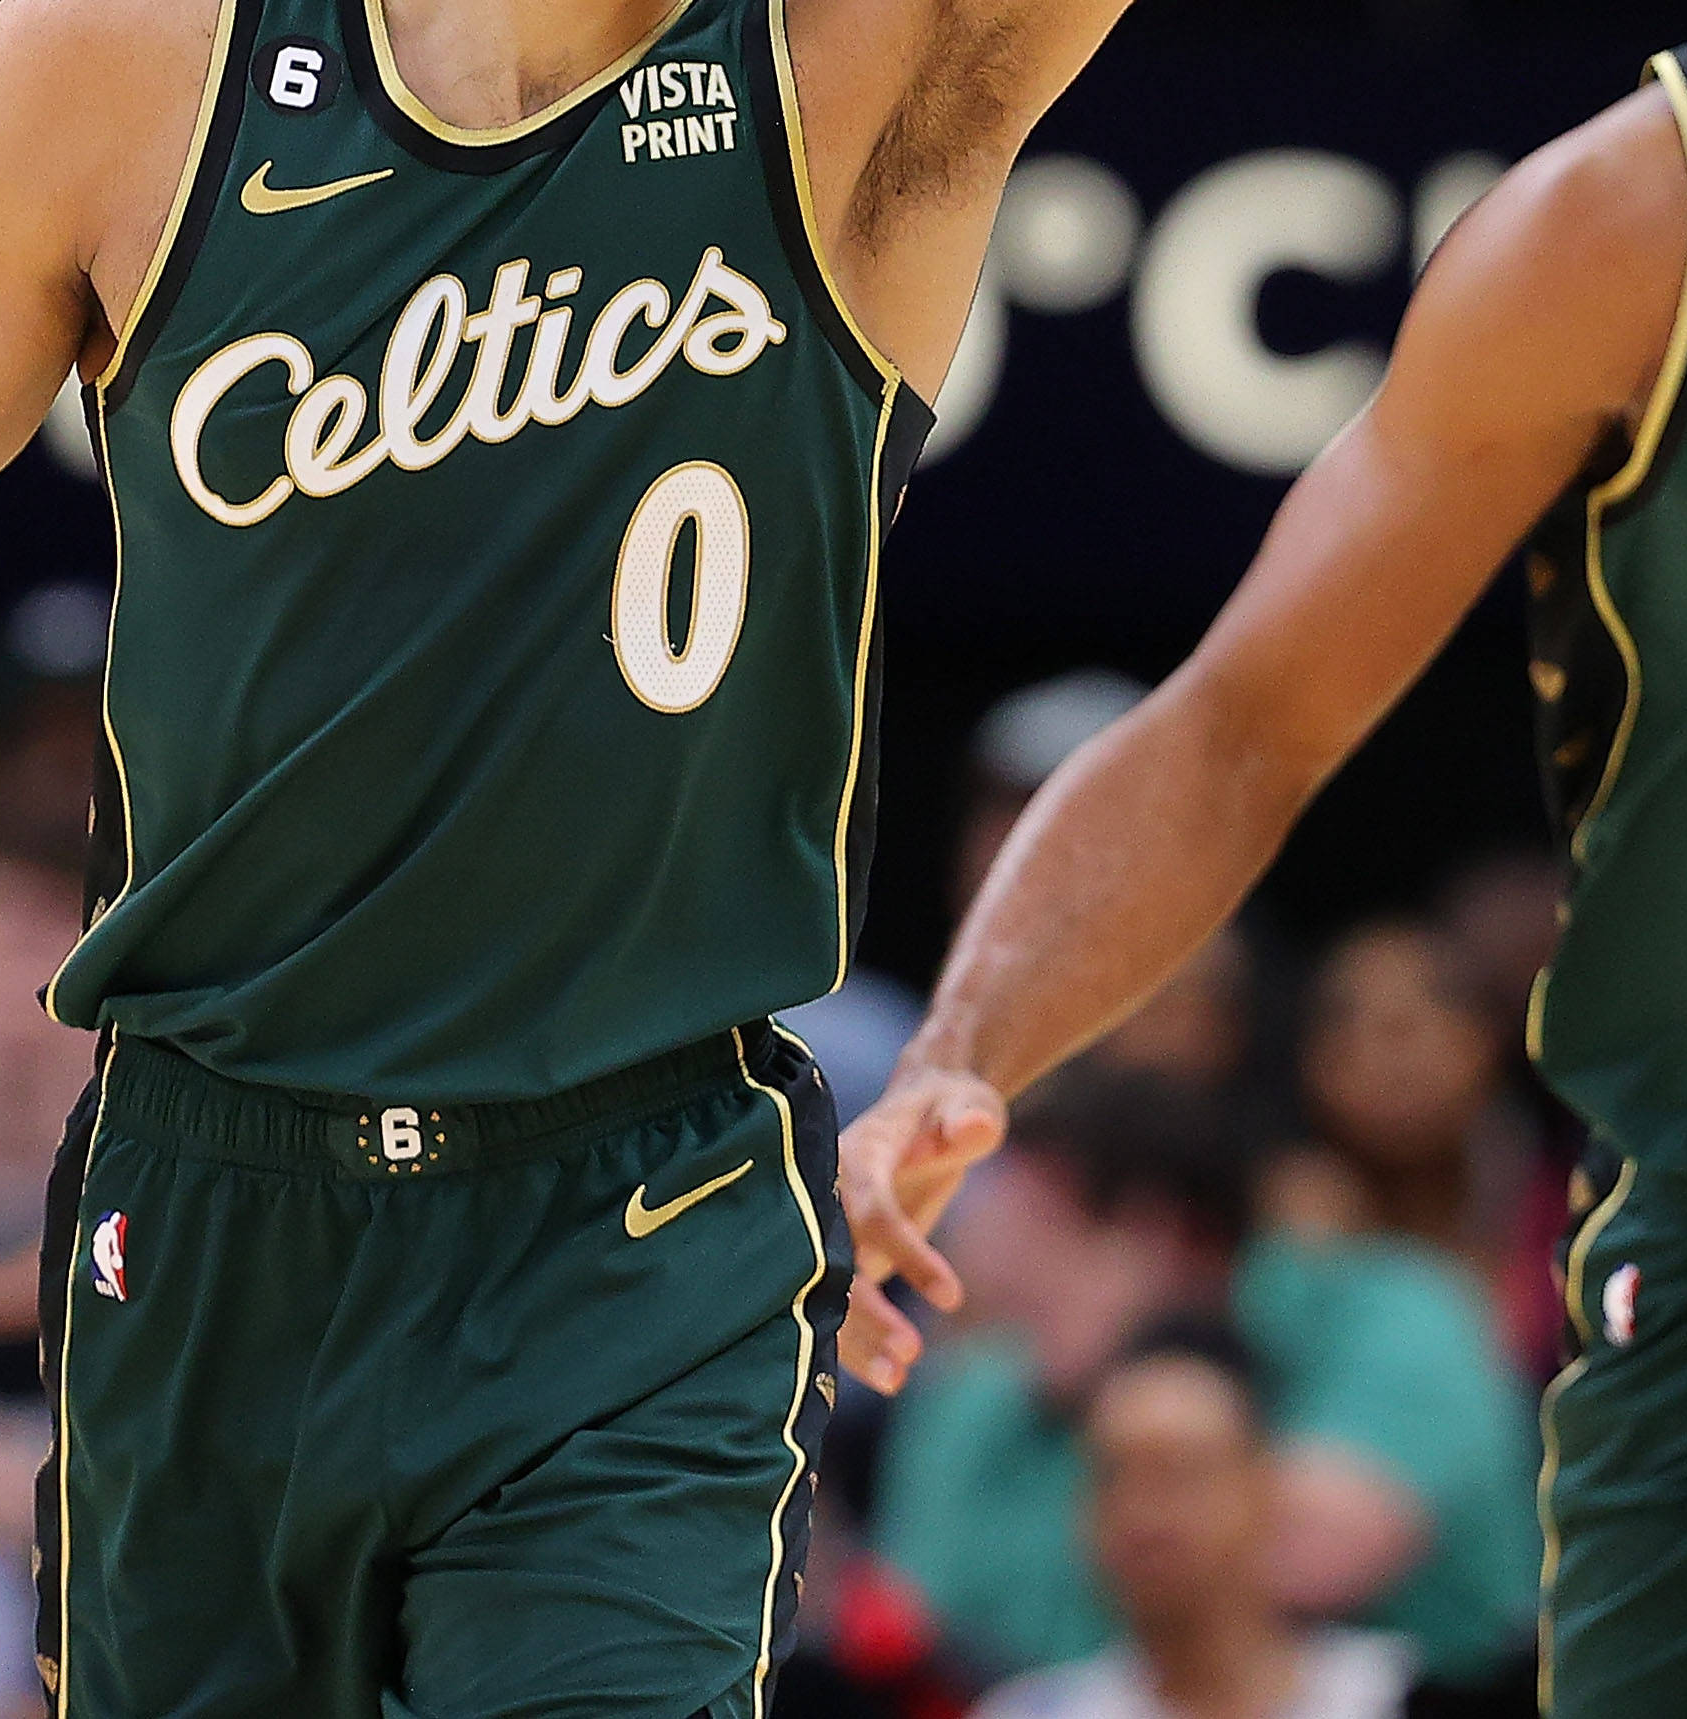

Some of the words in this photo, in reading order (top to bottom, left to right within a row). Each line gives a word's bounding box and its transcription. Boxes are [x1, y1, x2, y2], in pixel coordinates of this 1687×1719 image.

[269, 46, 323, 108] 6
[618, 62, 737, 119] VISTA
[621, 111, 738, 163] PRINT
[171, 246, 786, 527] Celtics
[612, 460, 751, 714] 0
[380, 1106, 422, 1161] 6
